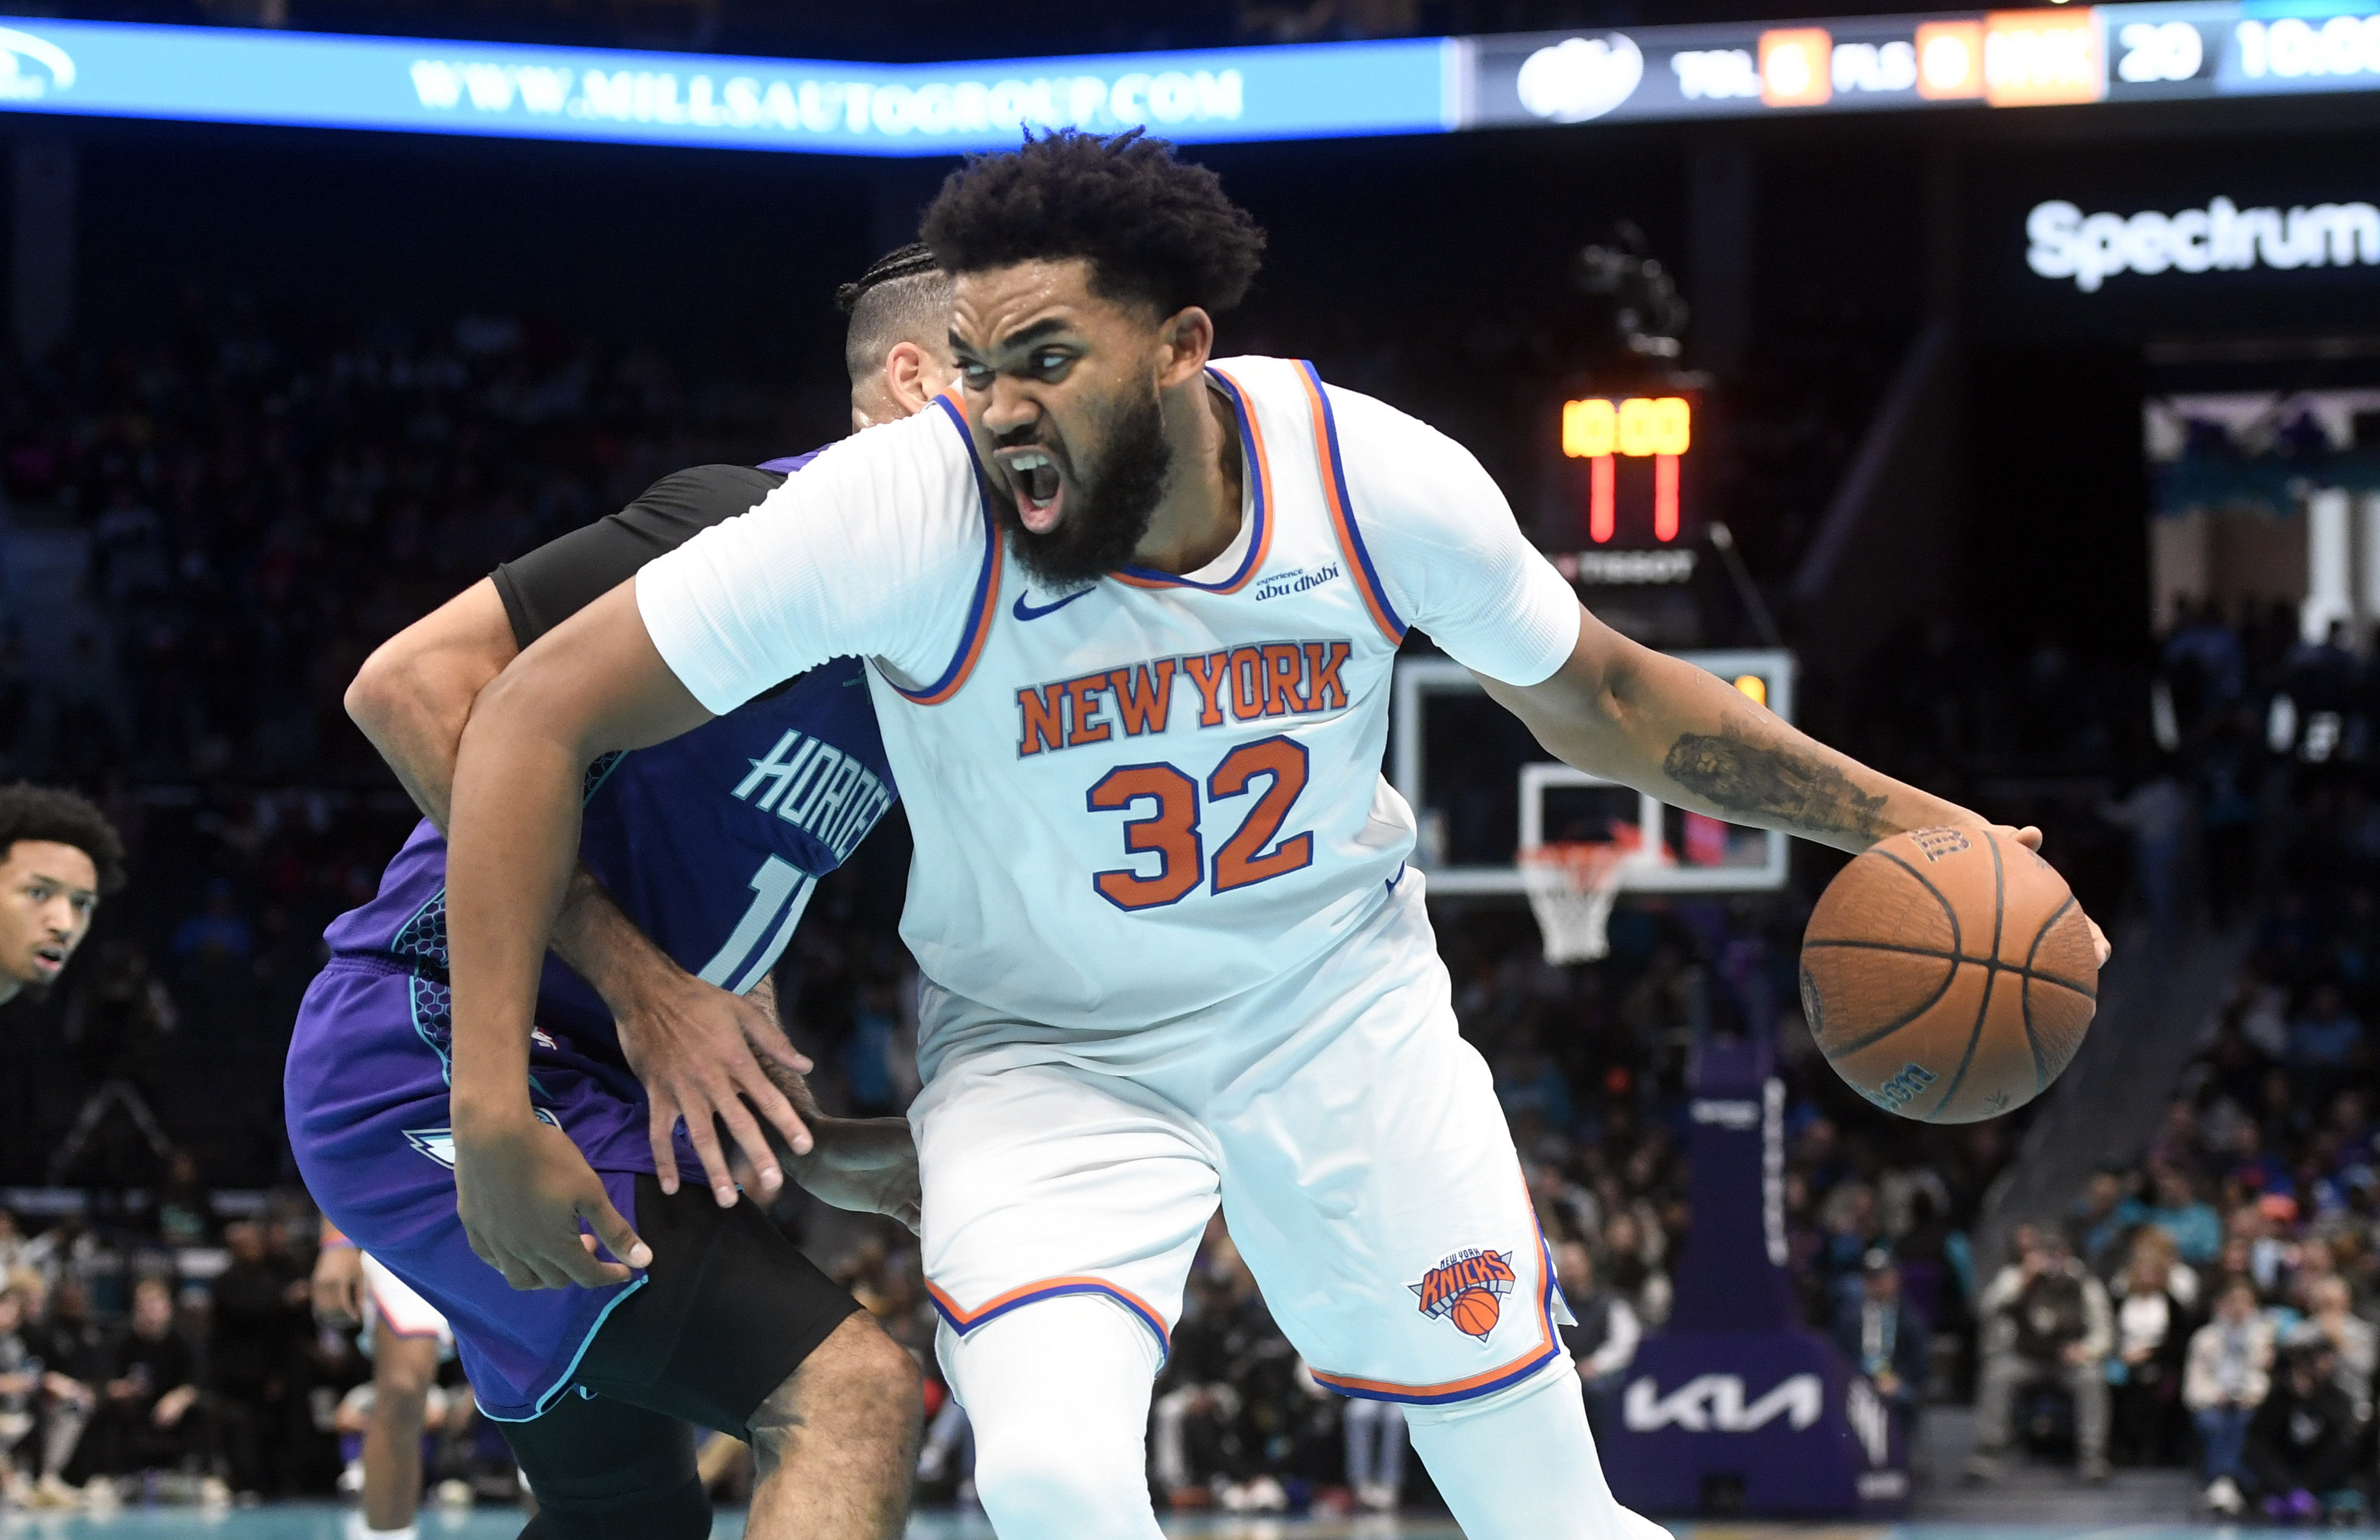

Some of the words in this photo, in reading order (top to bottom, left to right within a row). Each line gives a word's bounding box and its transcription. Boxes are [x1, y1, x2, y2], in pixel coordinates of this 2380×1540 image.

[2119, 21, 2202, 82] 20
[411, 60, 1243, 135] WWW.MILLSAUTOGROUP.COM
[2027, 195, 2380, 293] Spectrum
[1256, 584, 1290, 601] abu
[1257, 568, 1303, 586] experience
[1015, 656, 1177, 760] NEW
[1182, 638, 1352, 730] YORK
[1086, 734, 1313, 912] 32
[1419, 1250, 1516, 1313] KNICKS
[1441, 1254, 1457, 1269] NEW
[1459, 1248, 1481, 1260] YORK
